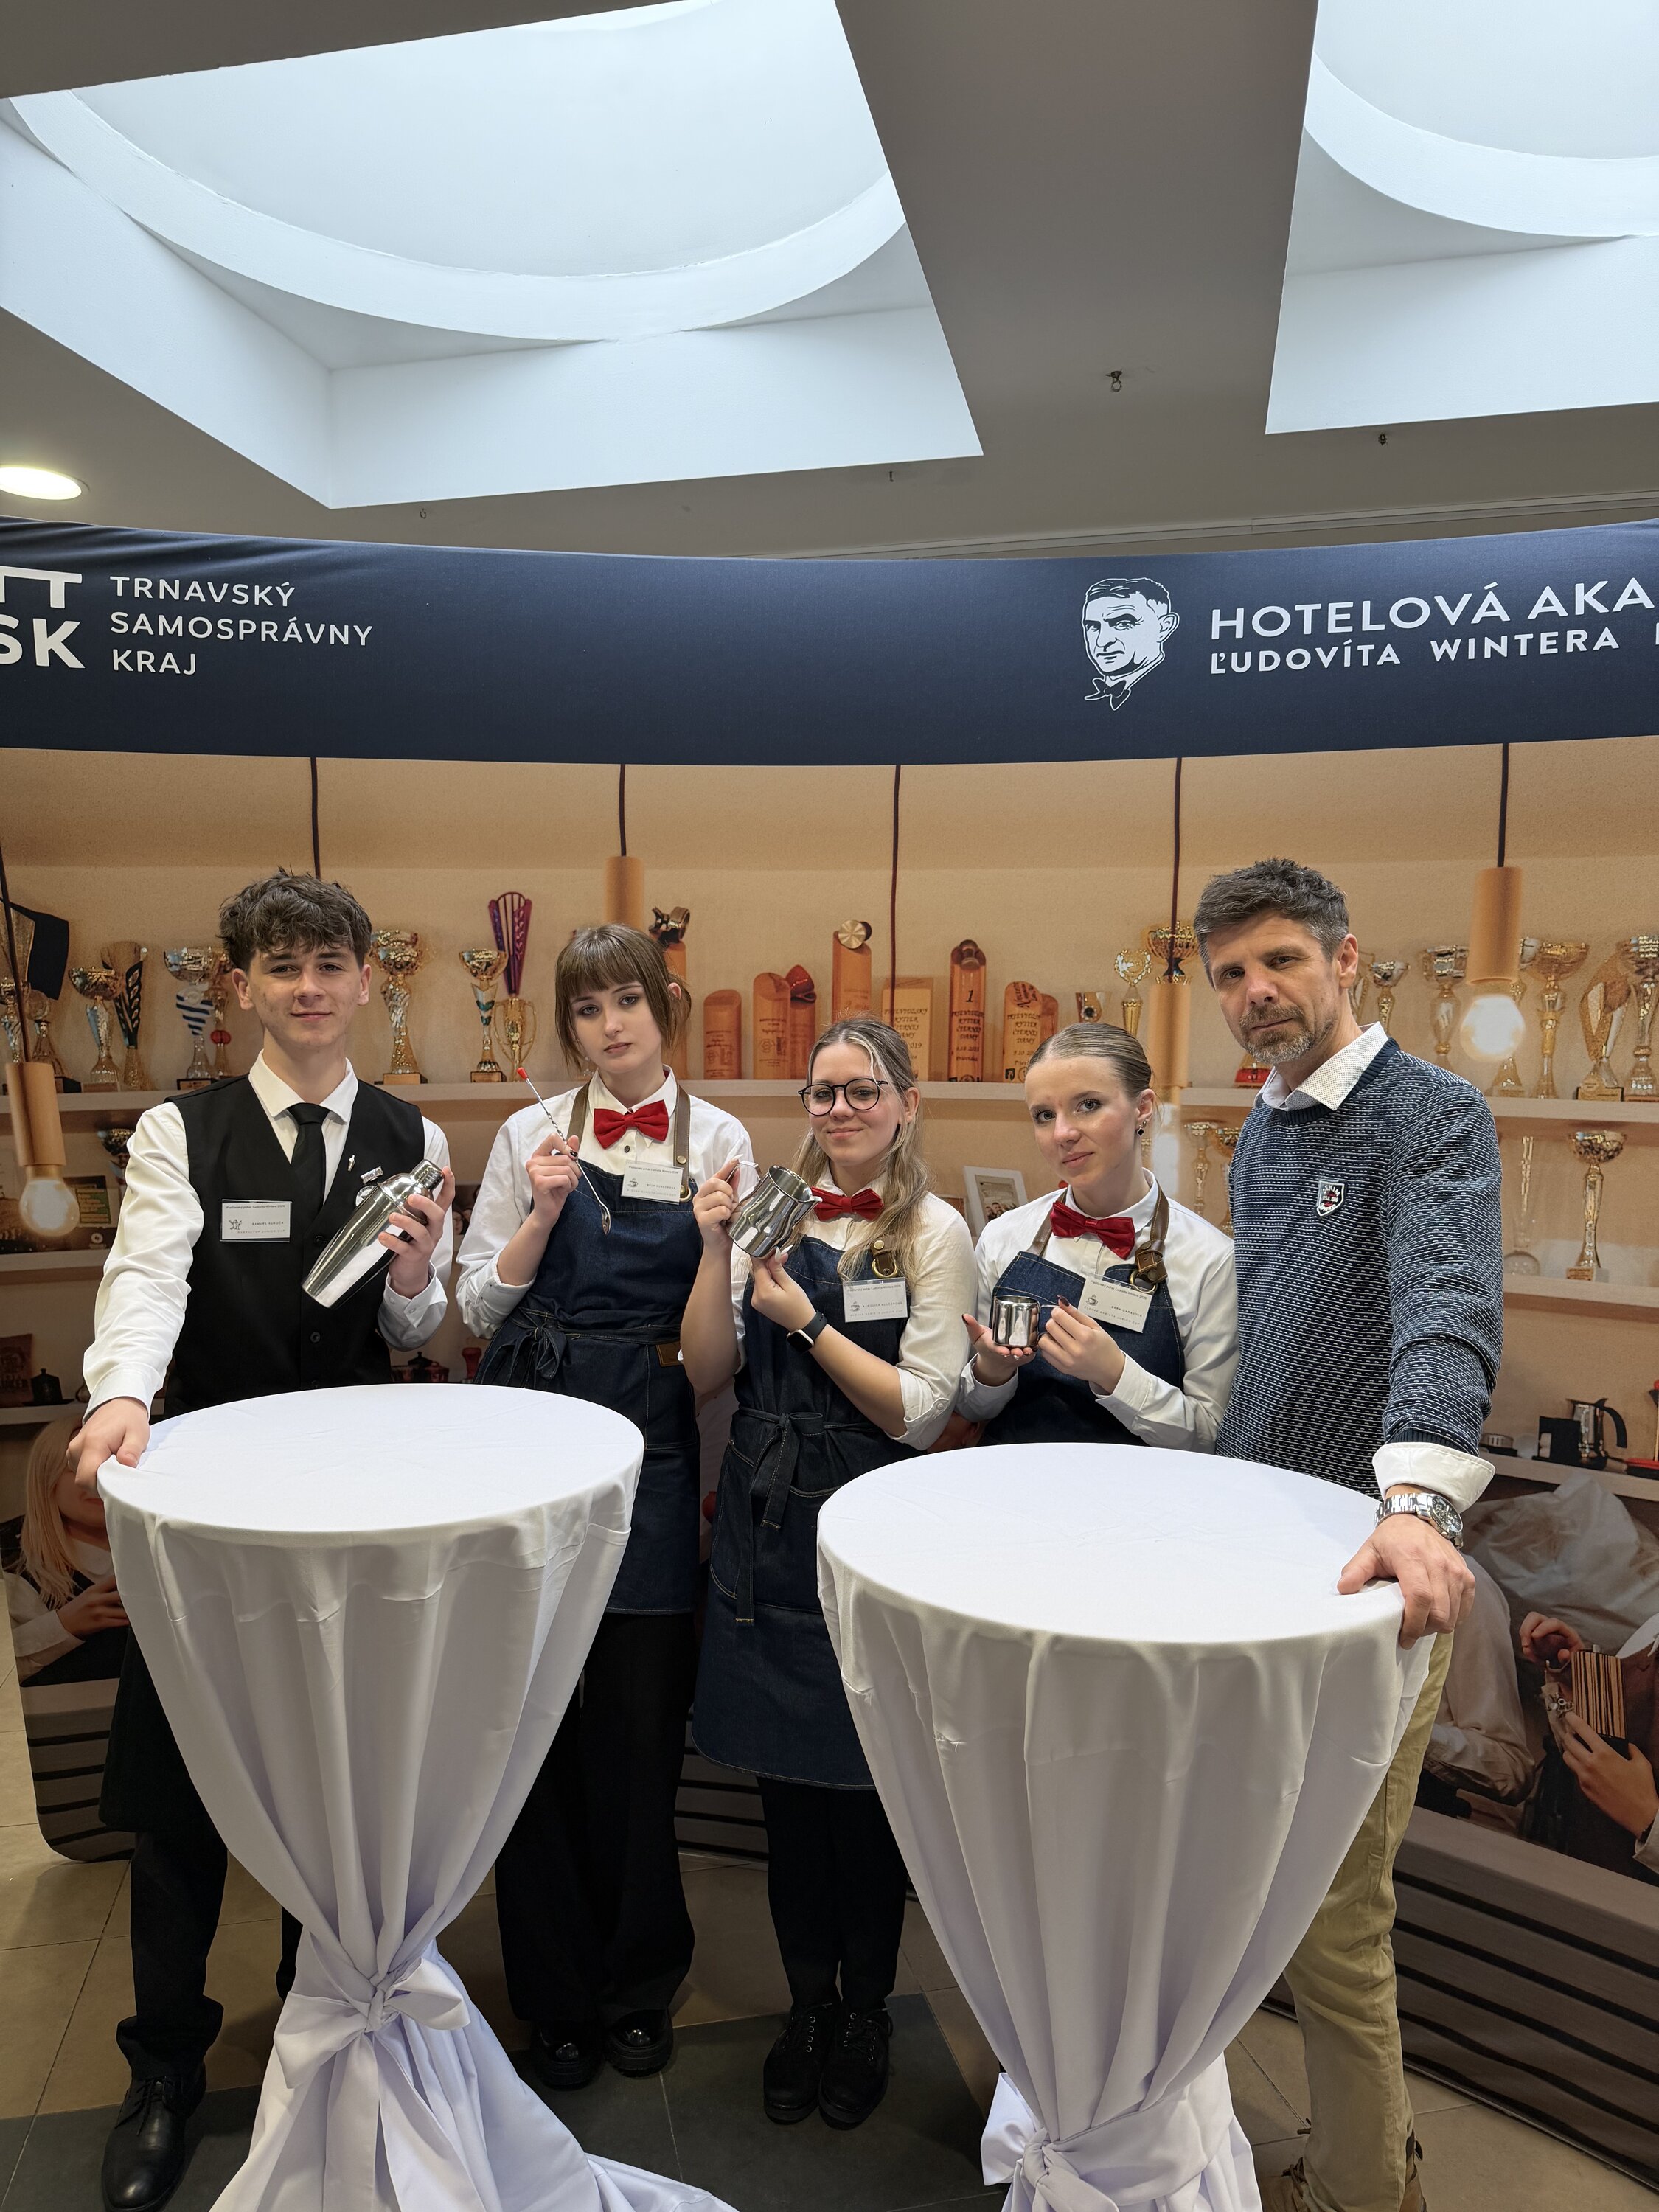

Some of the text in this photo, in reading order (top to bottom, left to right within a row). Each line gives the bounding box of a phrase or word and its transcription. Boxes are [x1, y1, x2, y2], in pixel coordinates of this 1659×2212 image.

[109, 576, 295, 606] TRNAVSKÝ
[1211, 577, 1655, 640] HOTELOVÁ AKA
[111, 612, 372, 646] SAMOSPRÁVNY
[113, 649, 196, 674] KRAJ
[1211, 639, 1400, 675] ĽUDOVÍTA
[1430, 627, 1619, 662] WINTERA
